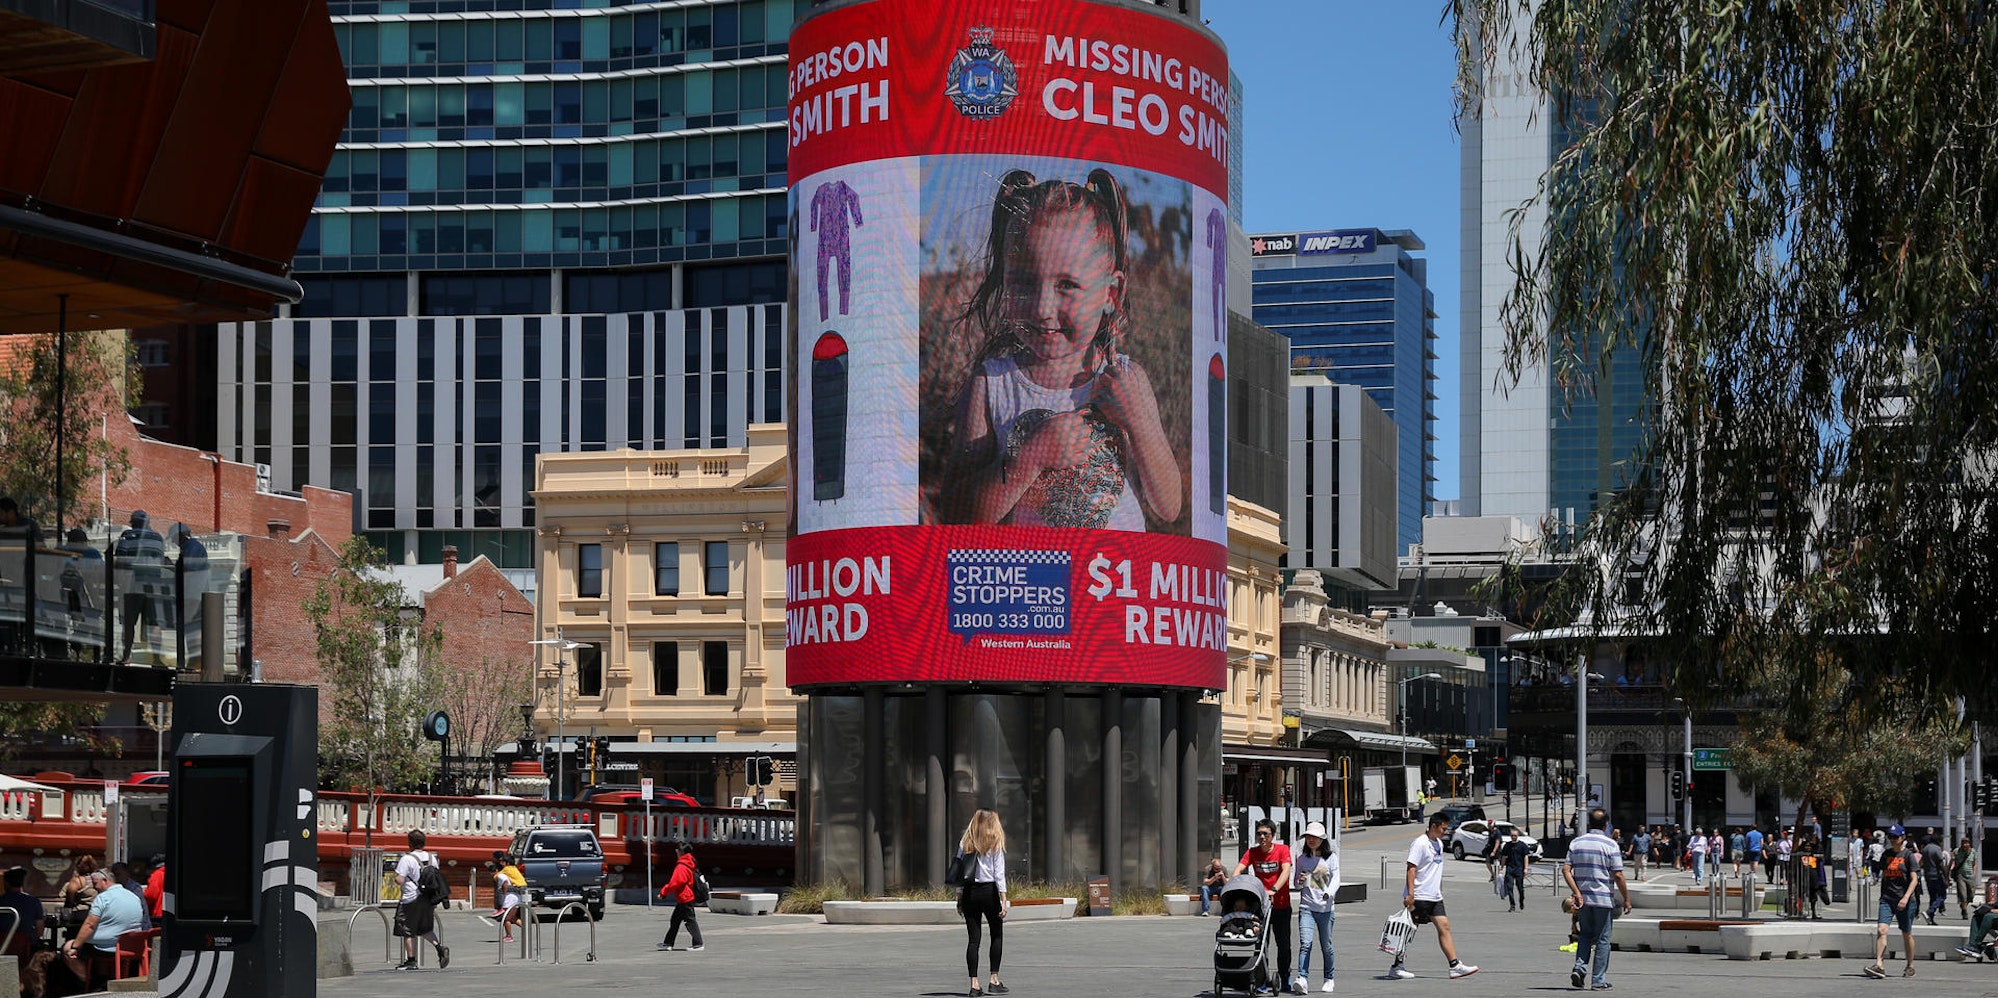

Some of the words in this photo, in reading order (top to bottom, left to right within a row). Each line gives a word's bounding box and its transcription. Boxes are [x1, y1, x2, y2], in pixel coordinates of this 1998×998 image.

[971, 48, 991, 57] WA
[797, 36, 889, 93] PERSON
[1044, 34, 1183, 91] MISSING
[792, 79, 889, 148] SMITH
[961, 105, 1000, 115] POLICE
[1042, 77, 1170, 136] CLEO
[1178, 104, 1228, 169] SMIT
[1267, 237, 1293, 251] nab
[1303, 234, 1369, 251] INPEX
[953, 565, 1028, 585] CRIME
[1086, 552, 1138, 602] $1
[1149, 561, 1227, 610] MILLIO
[952, 585, 1066, 605] STOPPERS
[1027, 605, 1065, 613] .com.au
[953, 613, 994, 628] 1800
[998, 613, 1029, 628] 333
[1033, 614, 1065, 629] 000
[980, 639, 1025, 649] Western
[1026, 639, 1071, 649] Australia
